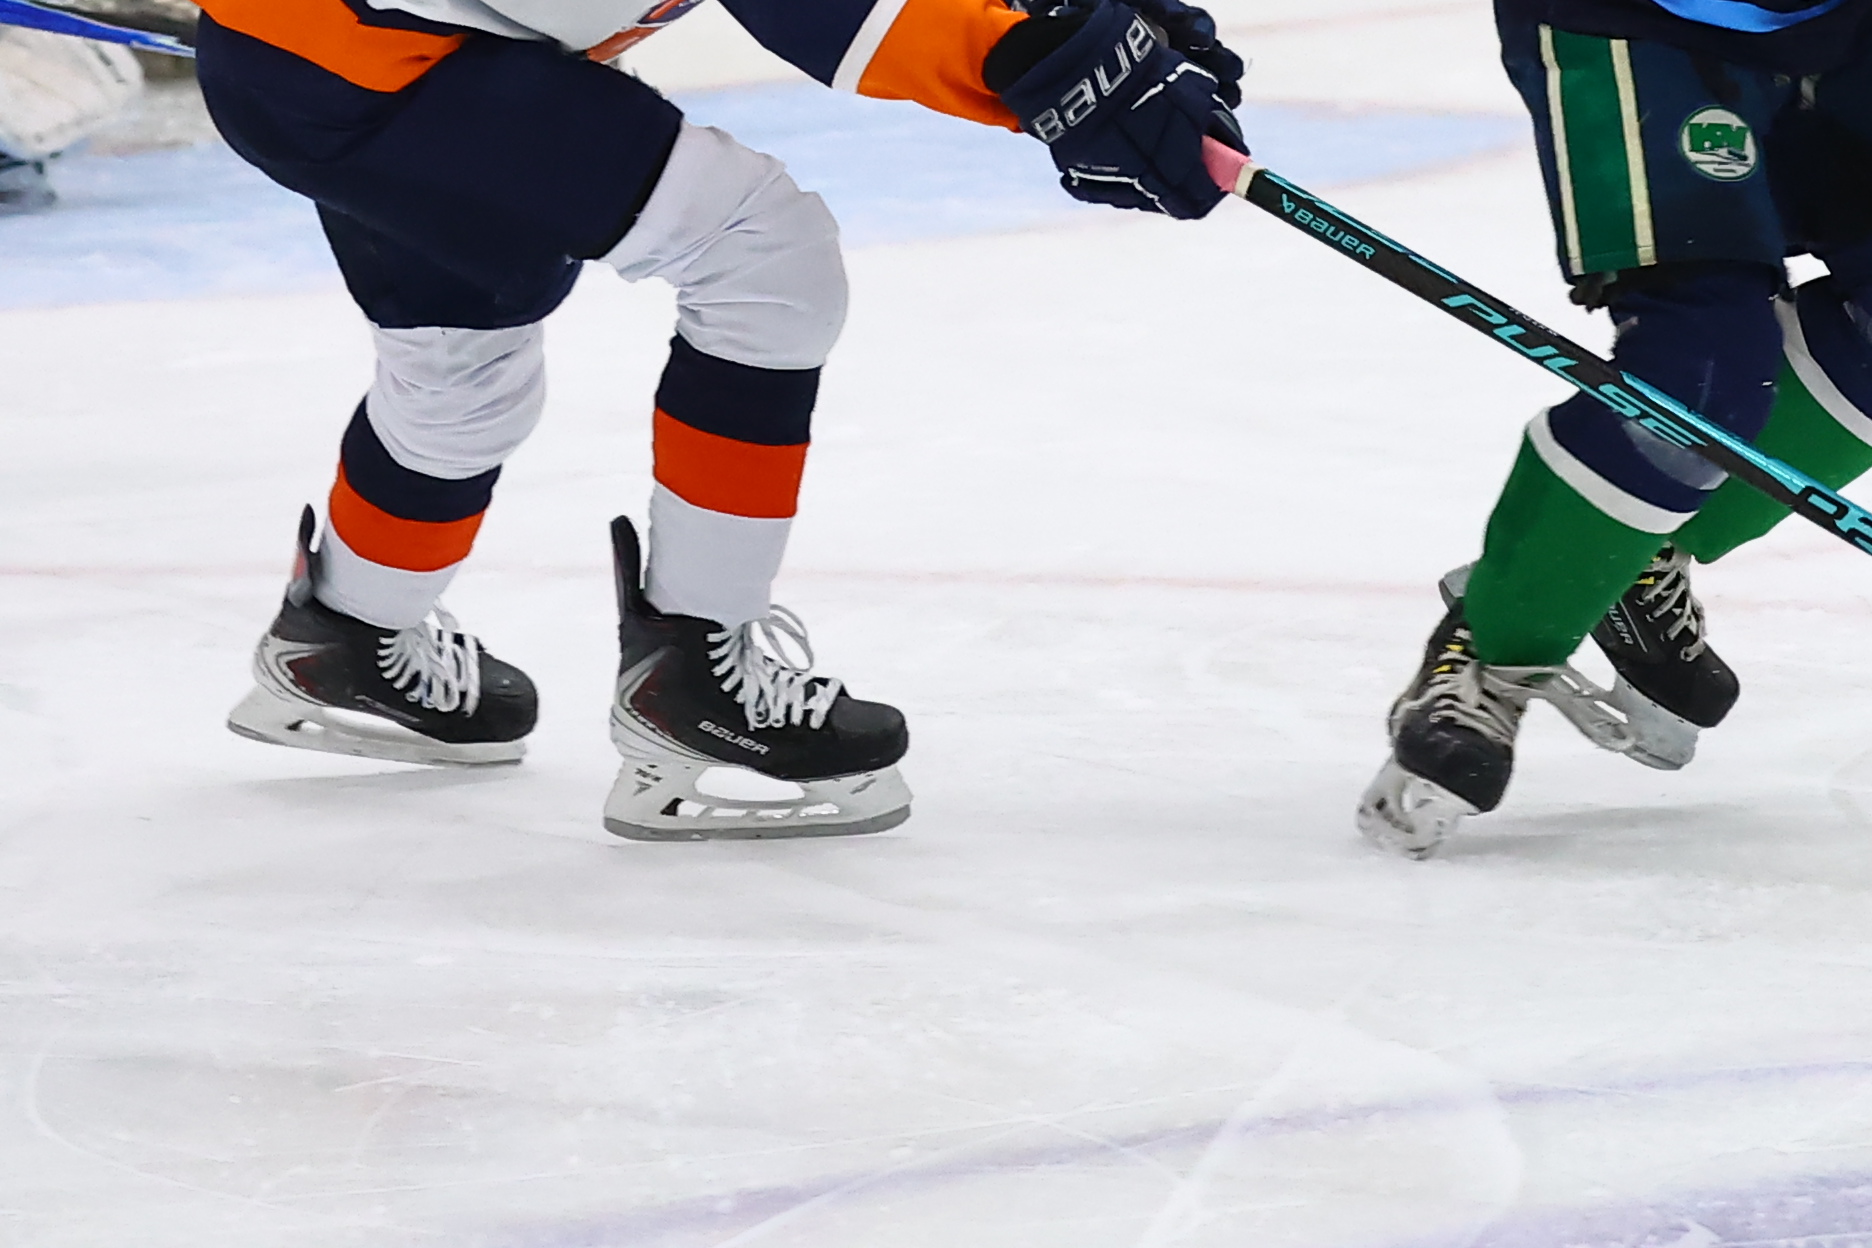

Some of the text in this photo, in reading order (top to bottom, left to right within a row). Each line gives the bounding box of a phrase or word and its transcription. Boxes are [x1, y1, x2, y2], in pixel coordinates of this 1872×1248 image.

[1030, 12, 1157, 144] BAUE
[1441, 293, 1709, 450] PULSE
[1608, 603, 1634, 645] UER
